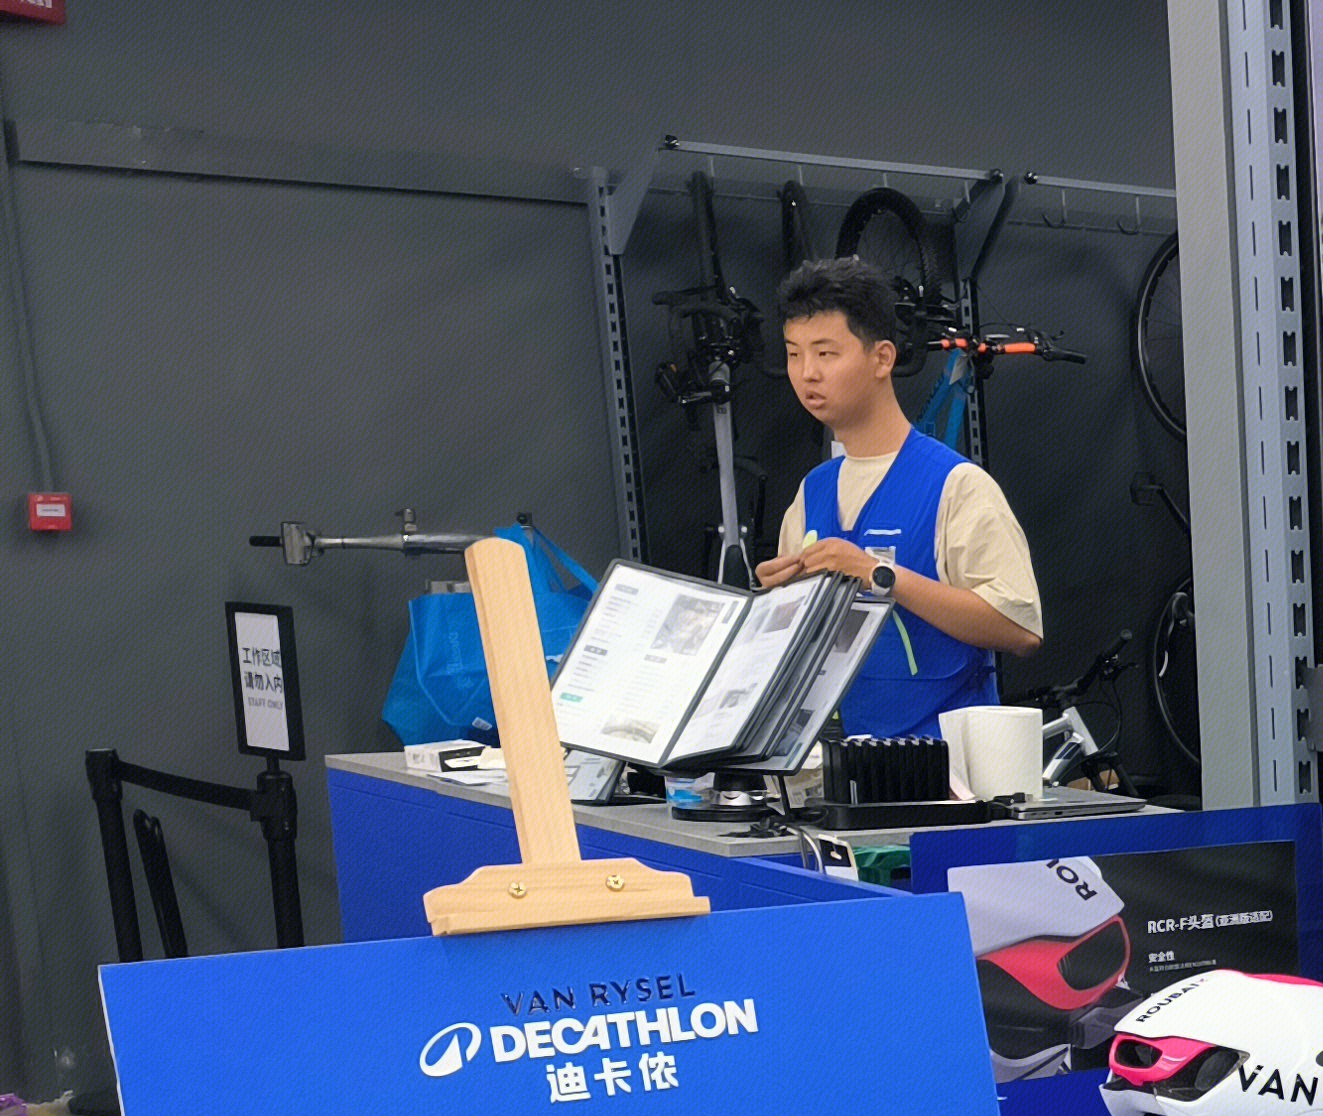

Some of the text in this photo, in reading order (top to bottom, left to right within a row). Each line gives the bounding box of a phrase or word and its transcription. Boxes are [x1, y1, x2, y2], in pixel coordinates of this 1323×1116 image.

[501, 972, 697, 1018] VAN RYSEL
[490, 997, 759, 1063] DECATHLON
[545, 1051, 679, 1104] 迪卡侬
[1238, 1063, 1318, 1108] VAN
